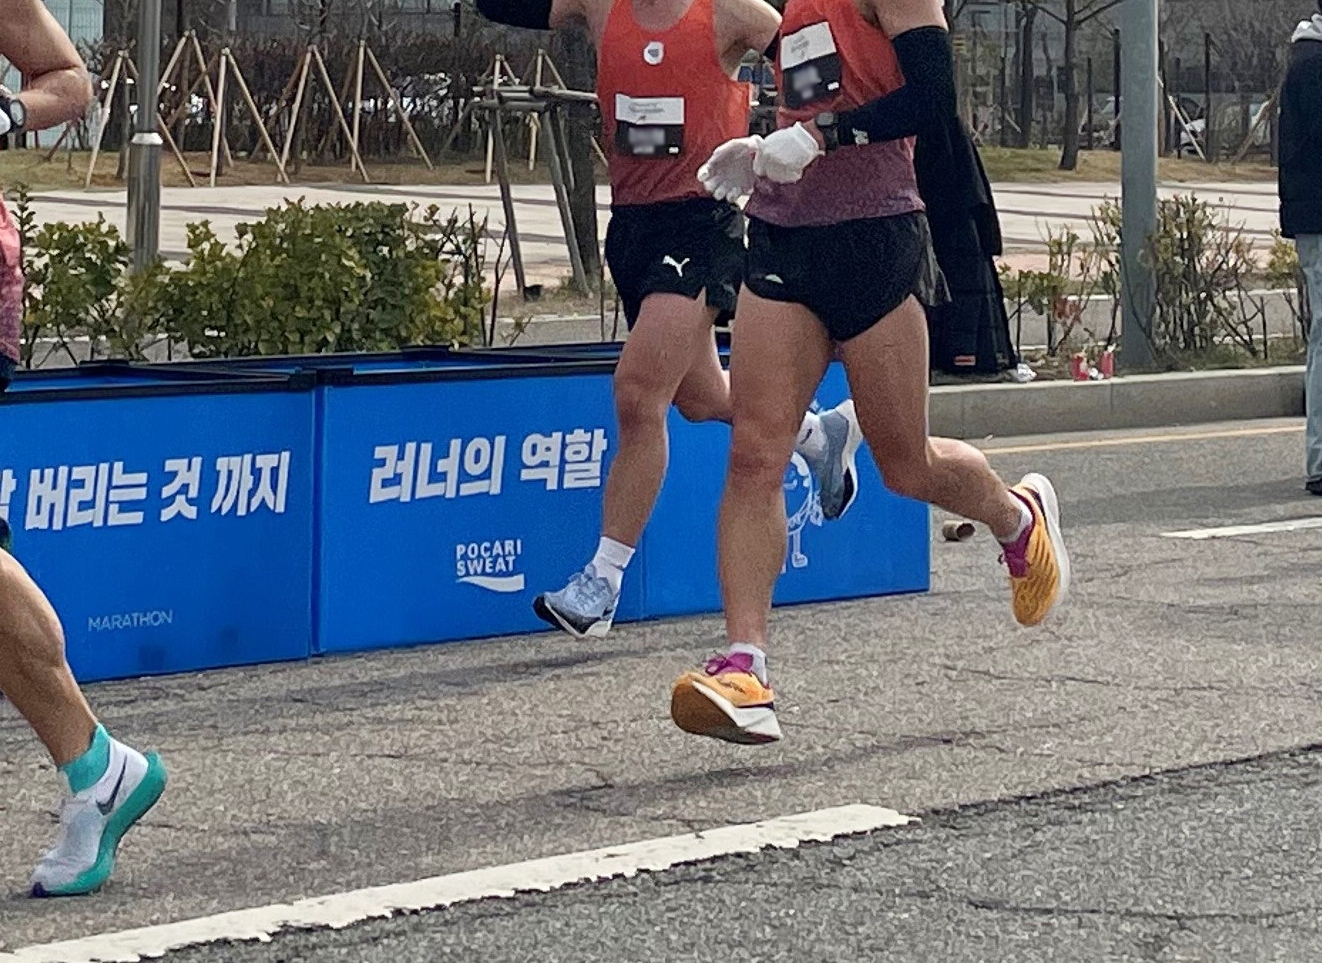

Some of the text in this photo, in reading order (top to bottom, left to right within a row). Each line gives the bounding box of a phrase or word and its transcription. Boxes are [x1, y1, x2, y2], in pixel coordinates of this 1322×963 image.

[369, 428, 608, 504] 러너의 역할
[25, 461, 147, 530] 버리는
[160, 456, 203, 523] 것
[210, 450, 291, 516] 까지
[455, 538, 522, 559] POCARI
[455, 555, 517, 577] SWEAT
[87, 609, 174, 633] MARATHON
